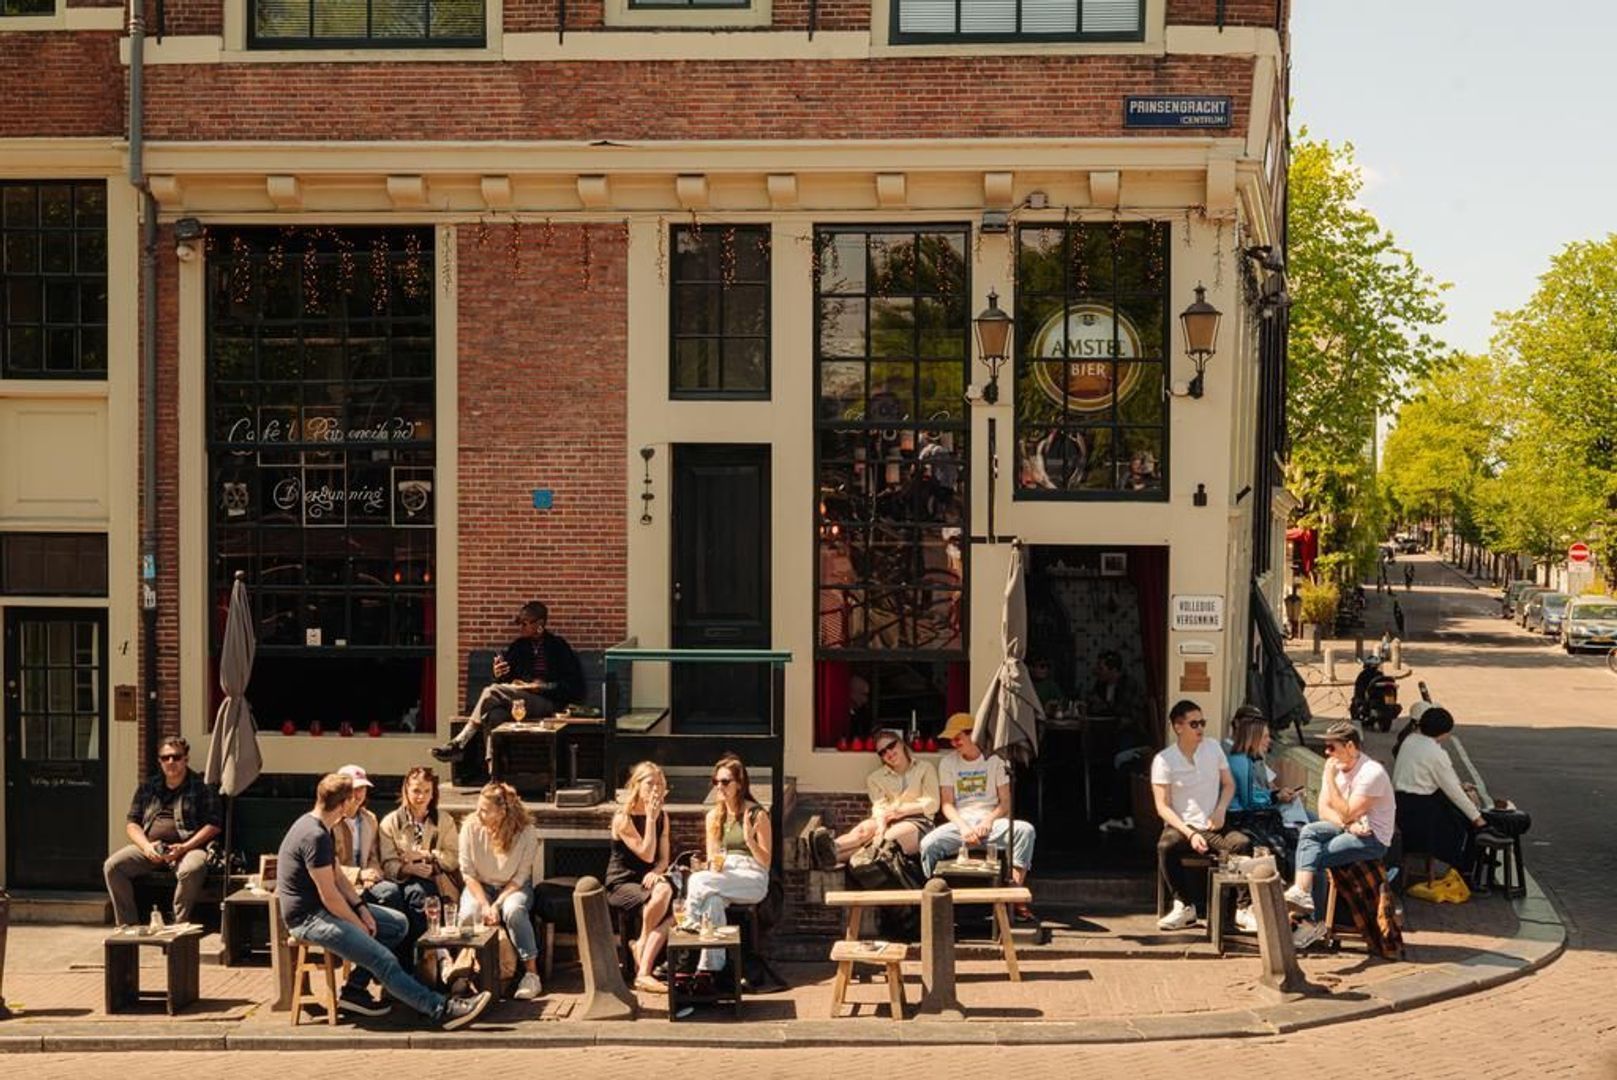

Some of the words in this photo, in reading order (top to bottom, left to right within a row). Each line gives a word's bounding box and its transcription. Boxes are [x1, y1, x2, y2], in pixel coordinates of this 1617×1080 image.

[1129, 100, 1227, 114] PRINSENGRACHT
[1051, 339, 1126, 357] AMSTEL
[1071, 363, 1106, 376] BIER
